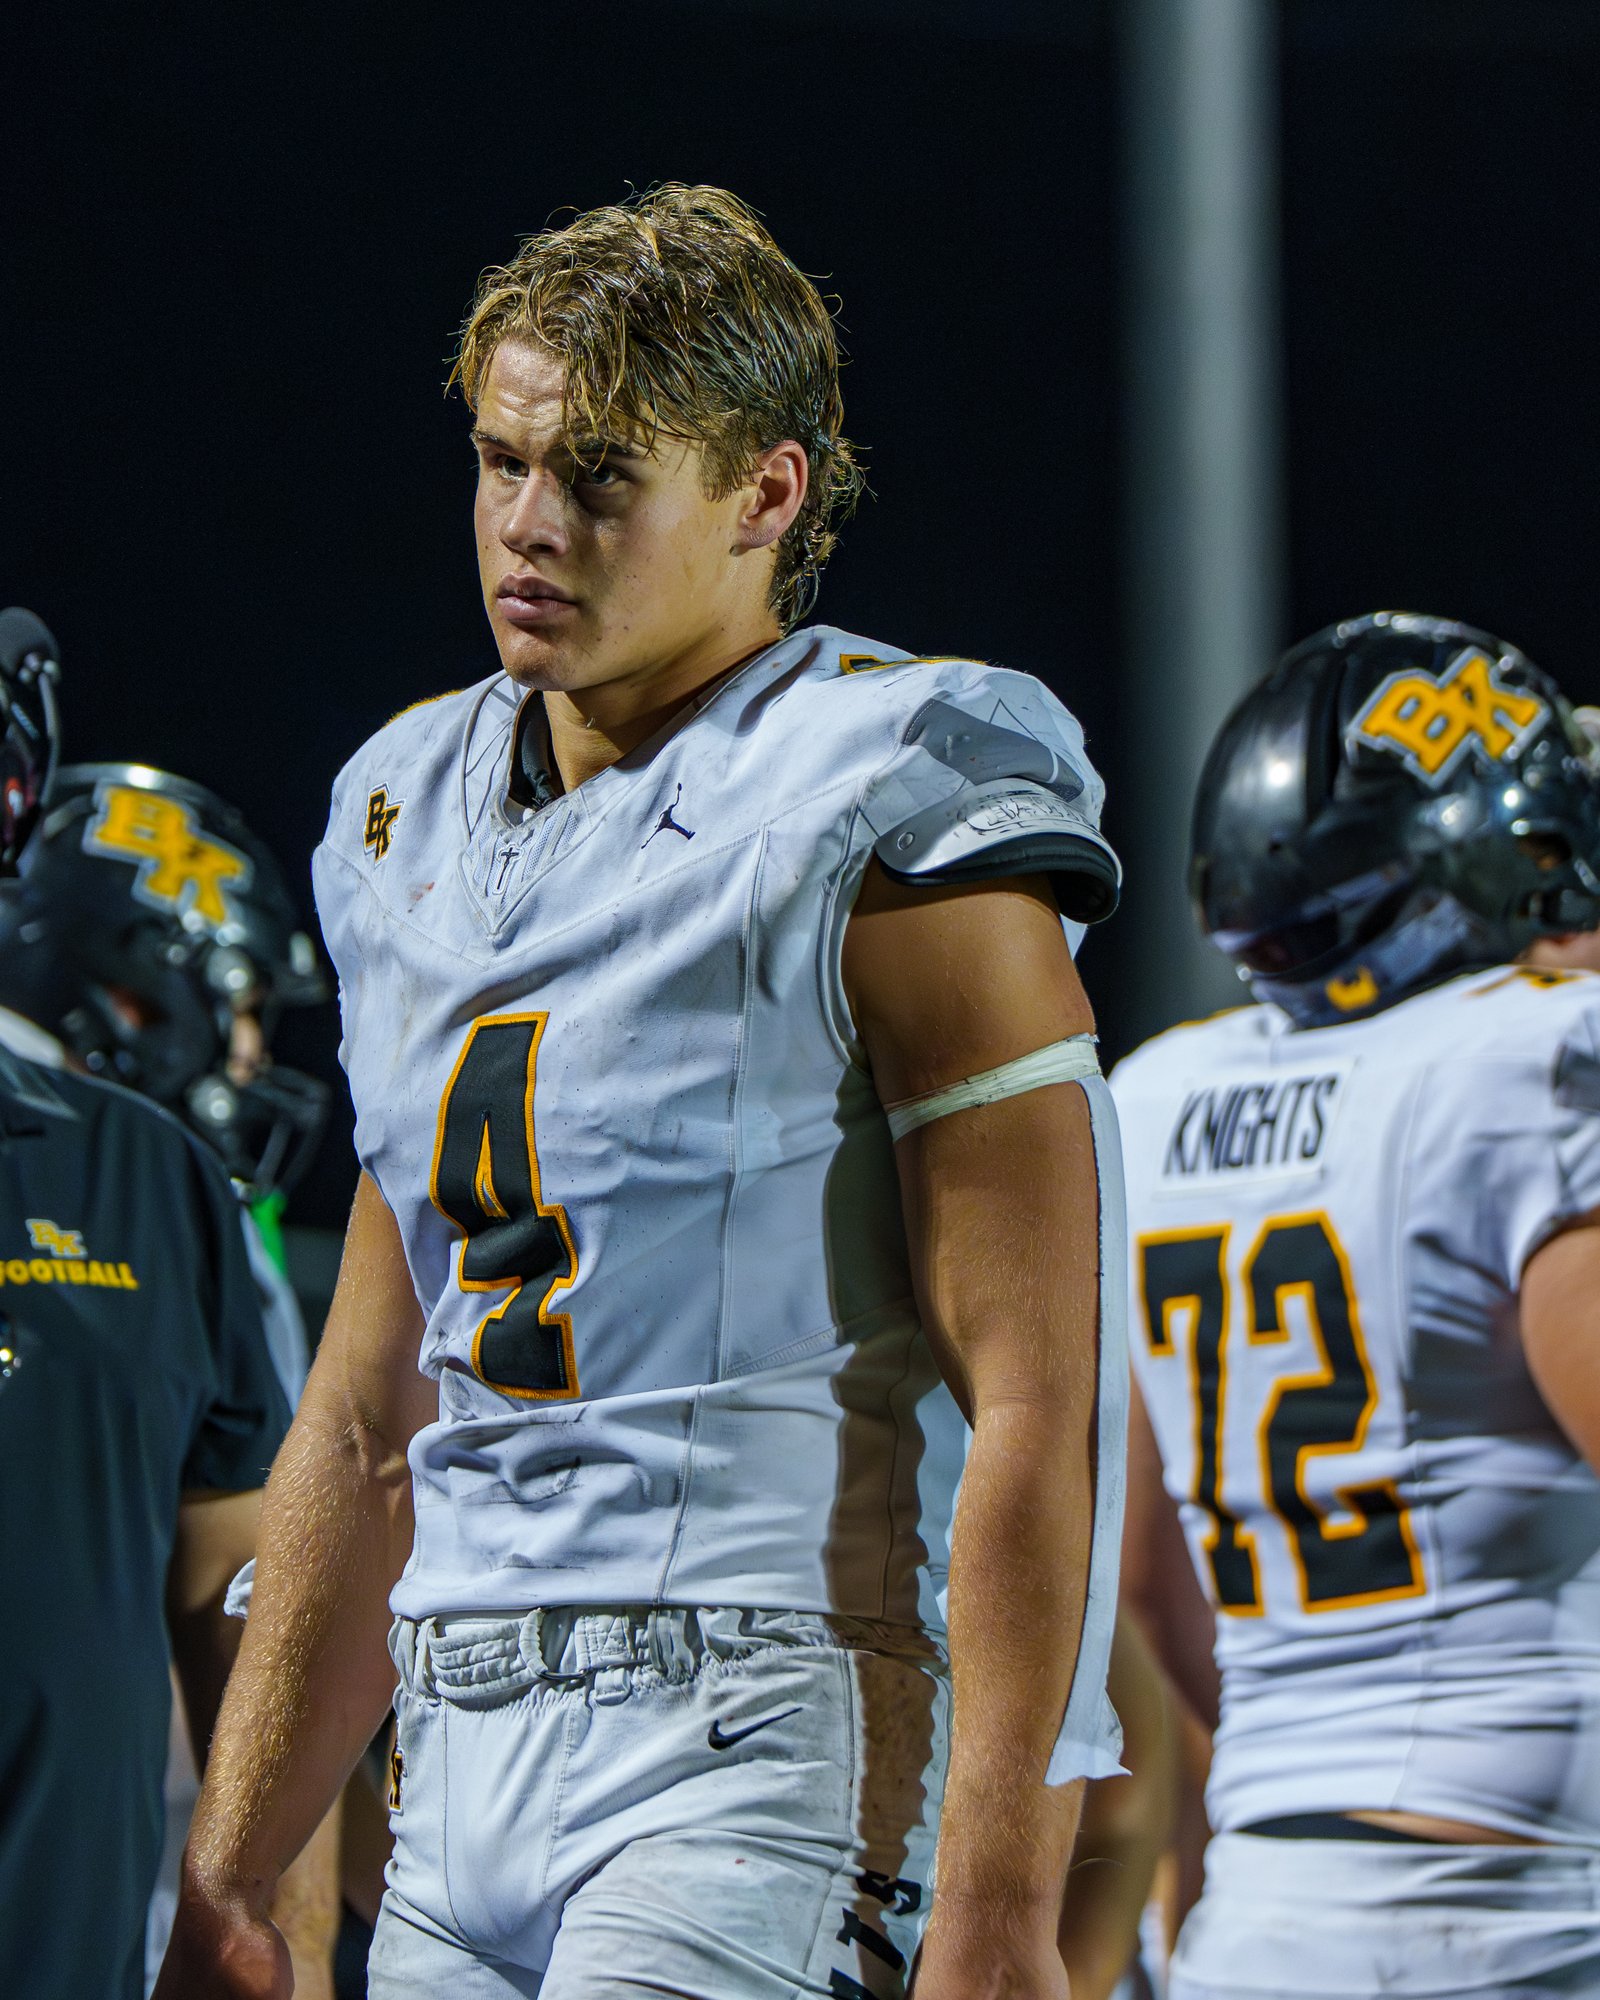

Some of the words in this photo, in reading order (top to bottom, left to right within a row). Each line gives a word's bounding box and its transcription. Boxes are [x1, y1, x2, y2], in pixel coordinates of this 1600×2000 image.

[364, 784, 404, 866] BK
[429, 1010, 581, 1399] 4
[1162, 1071, 1339, 1177] KNIGHTS
[1136, 1207, 1428, 1617] 72
